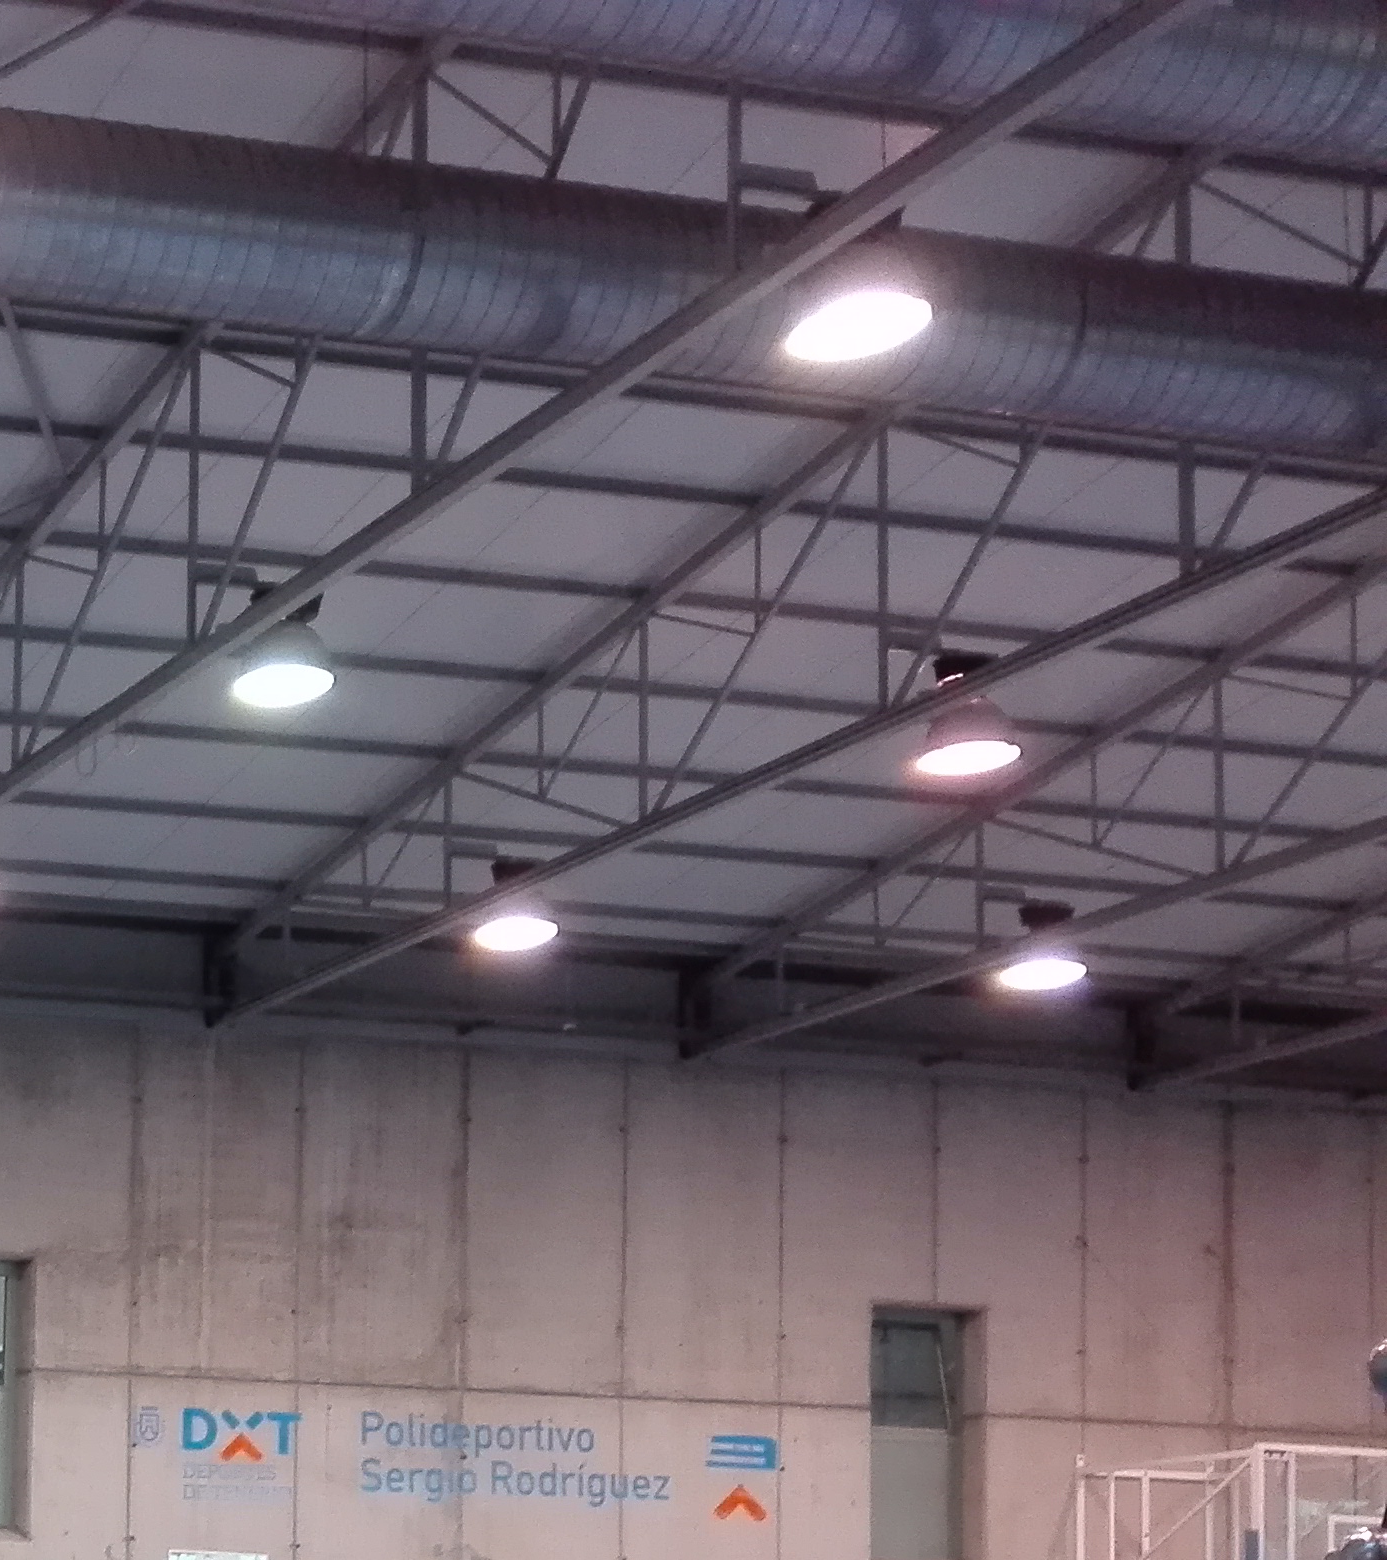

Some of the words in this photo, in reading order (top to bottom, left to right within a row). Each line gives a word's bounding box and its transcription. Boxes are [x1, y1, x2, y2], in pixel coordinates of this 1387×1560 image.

[182, 1407, 302, 1461] DXT
[360, 1411, 595, 1457] Polideportivo
[360, 1458, 477, 1502] Sergio
[490, 1460, 671, 1507] Rodríguez
